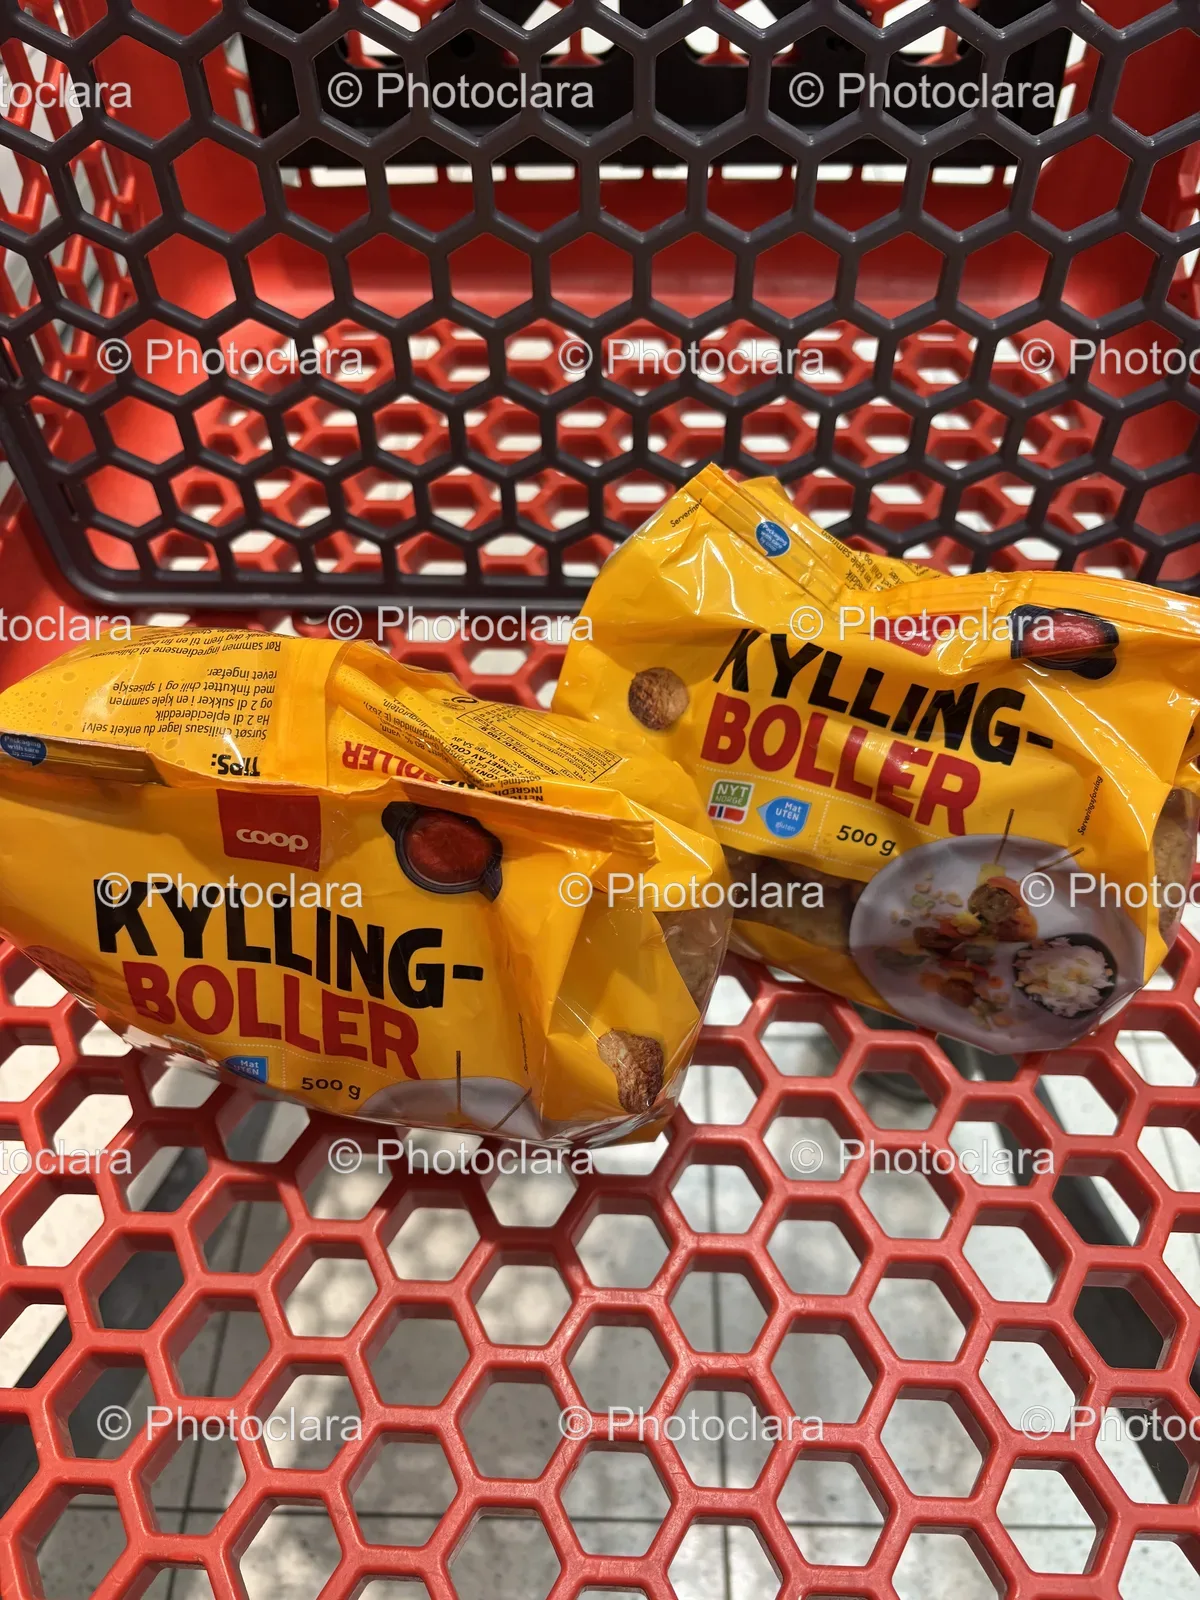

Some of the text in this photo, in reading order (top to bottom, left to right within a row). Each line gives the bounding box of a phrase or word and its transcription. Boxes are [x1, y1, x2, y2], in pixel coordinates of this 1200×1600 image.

[190, 638, 201, 646] til
[222, 641, 263, 651] sammen
[265, 641, 281, 651] Rør
[153, 645, 220, 657] ingrediensene
[207, 667, 277, 681] revet ingefær.
[112, 681, 155, 694] spiseskje
[165, 680, 179, 689] og
[181, 682, 201, 692] chili
[203, 682, 250, 696] finkuttet
[253, 685, 275, 696] med
[109, 697, 150, 706] sammen
[152, 693, 174, 707] kjele
[176, 696, 188, 704] en
[197, 696, 234, 708] sukker
[713, 628, 1054, 765] KYLLING-
[237, 699, 247, 711] dl
[250, 700, 257, 711] 2
[260, 698, 272, 709] og
[155, 707, 269, 726] Ha 2 dl eplecidereddik
[82, 722, 108, 734] selv!
[110, 725, 141, 736] enkelt
[144, 725, 156, 736] du
[158, 722, 183, 735] lager
[380, 724, 401, 738] vann,
[235, 729, 267, 740] Sursøt
[211, 754, 260, 776] TIPS:
[700, 693, 981, 836] BOLLER
[716, 784, 749, 798] NYT
[784, 801, 802, 813] Mat
[775, 808, 799, 821] UTEN
[236, 827, 309, 853] coop
[836, 824, 897, 857] 500 g
[93, 878, 484, 1009] KYLLING-
[122, 960, 421, 1080] BOLLER
[240, 1060, 259, 1068] Mat
[301, 1077, 361, 1100] 500 g
